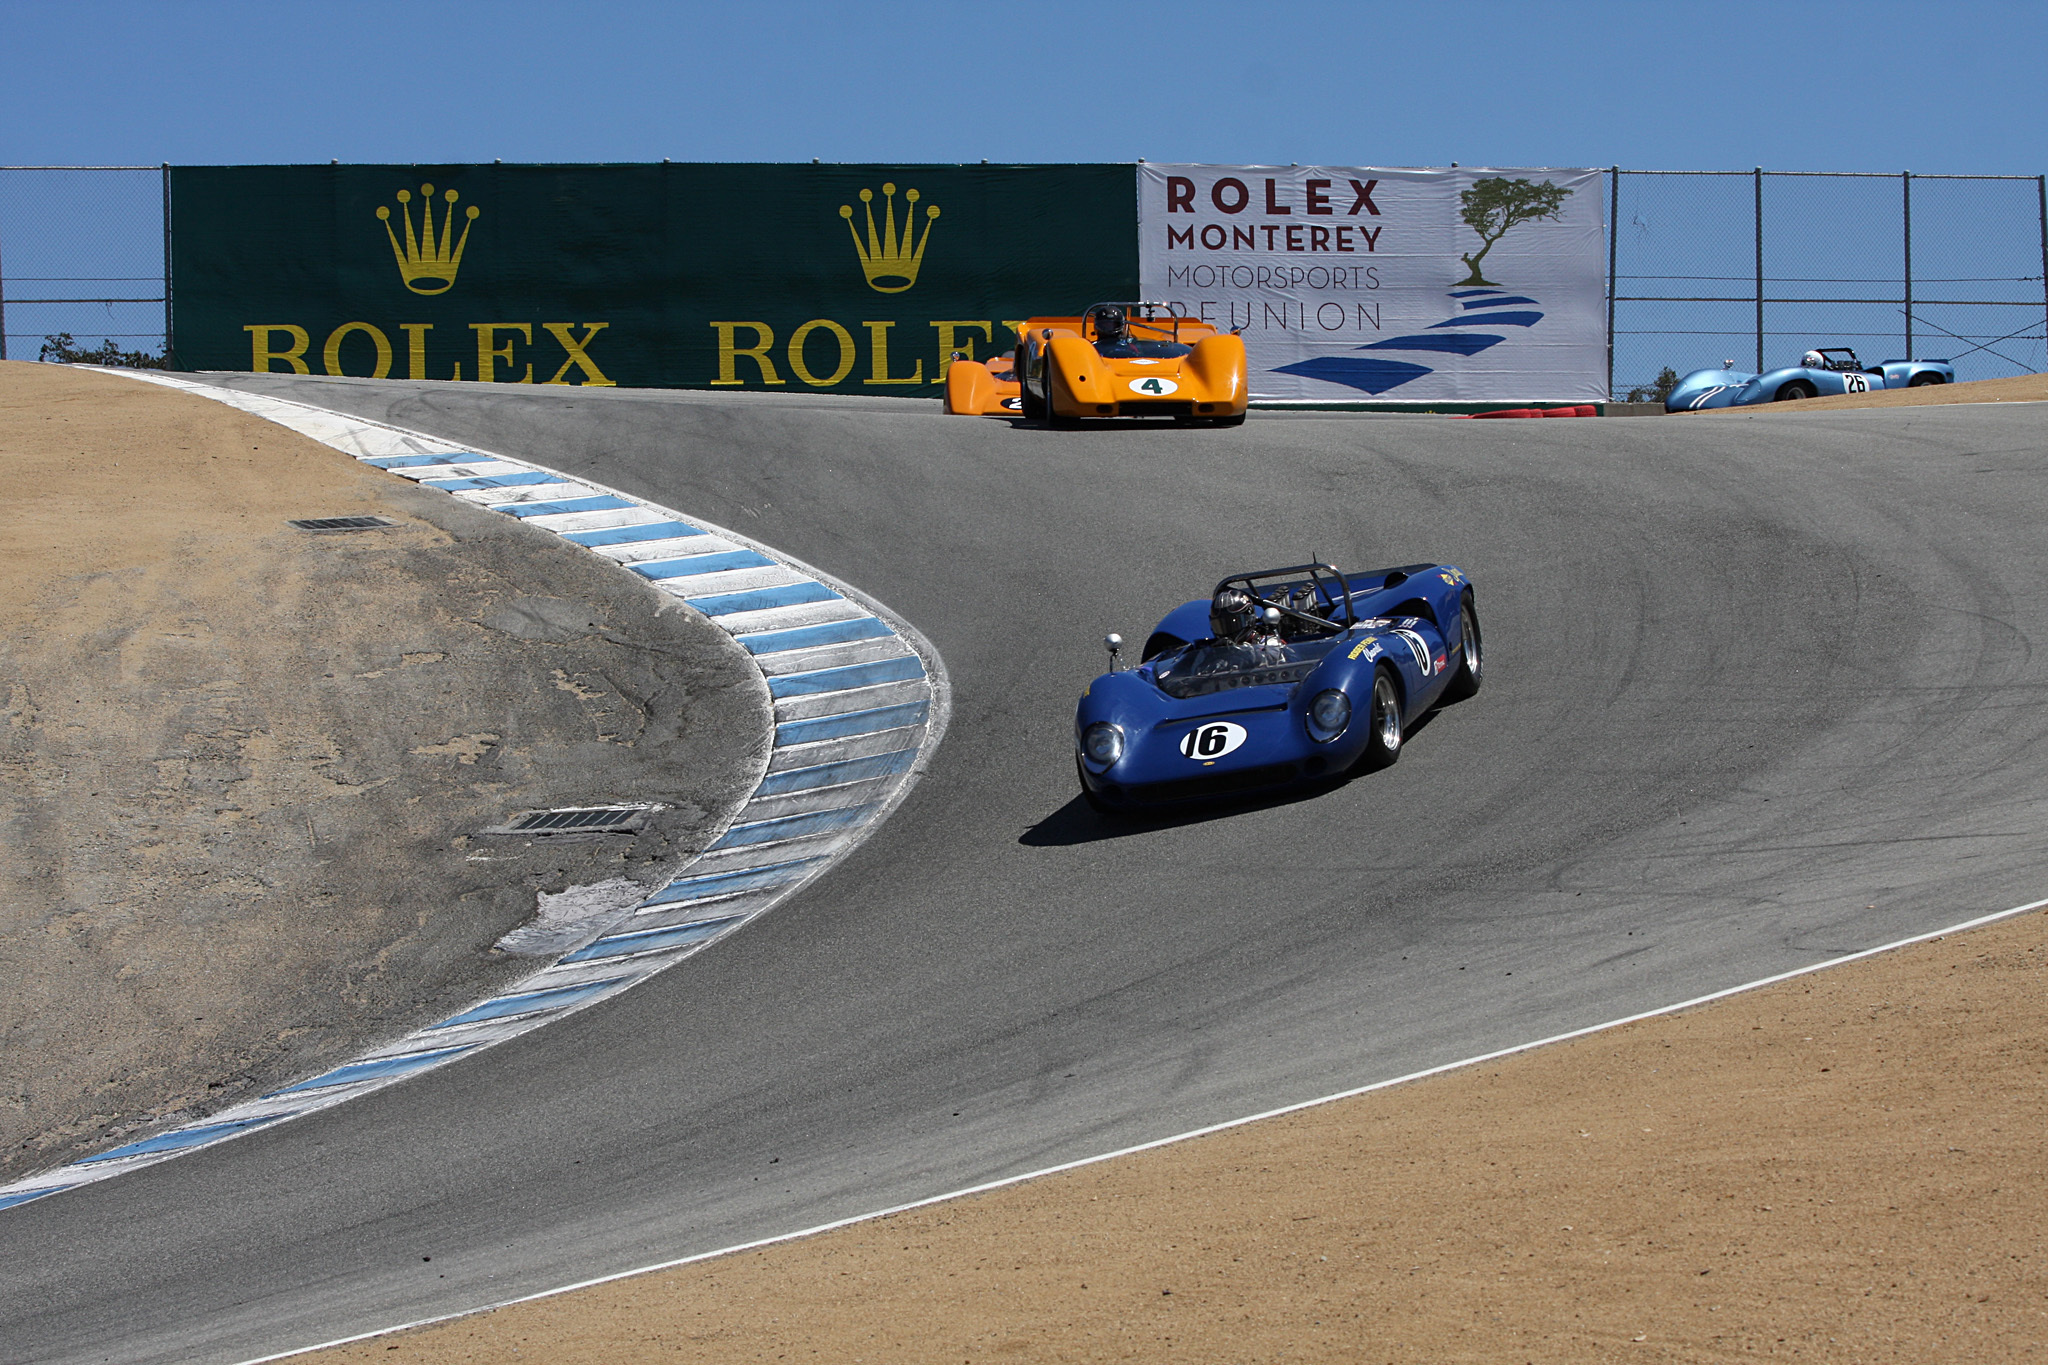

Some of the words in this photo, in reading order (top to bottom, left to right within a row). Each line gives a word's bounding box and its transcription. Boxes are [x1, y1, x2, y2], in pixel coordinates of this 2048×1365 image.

[1167, 176, 1381, 216] ROLEX
[1167, 223, 1383, 252] MONTEREY
[1168, 264, 1380, 290] MOTORSPORTS
[243, 321, 617, 387] ROLEX
[709, 318, 1027, 387] ROLE
[1141, 378, 1163, 394] 4
[1844, 374, 1866, 393] 26
[1184, 725, 1229, 758] 16
